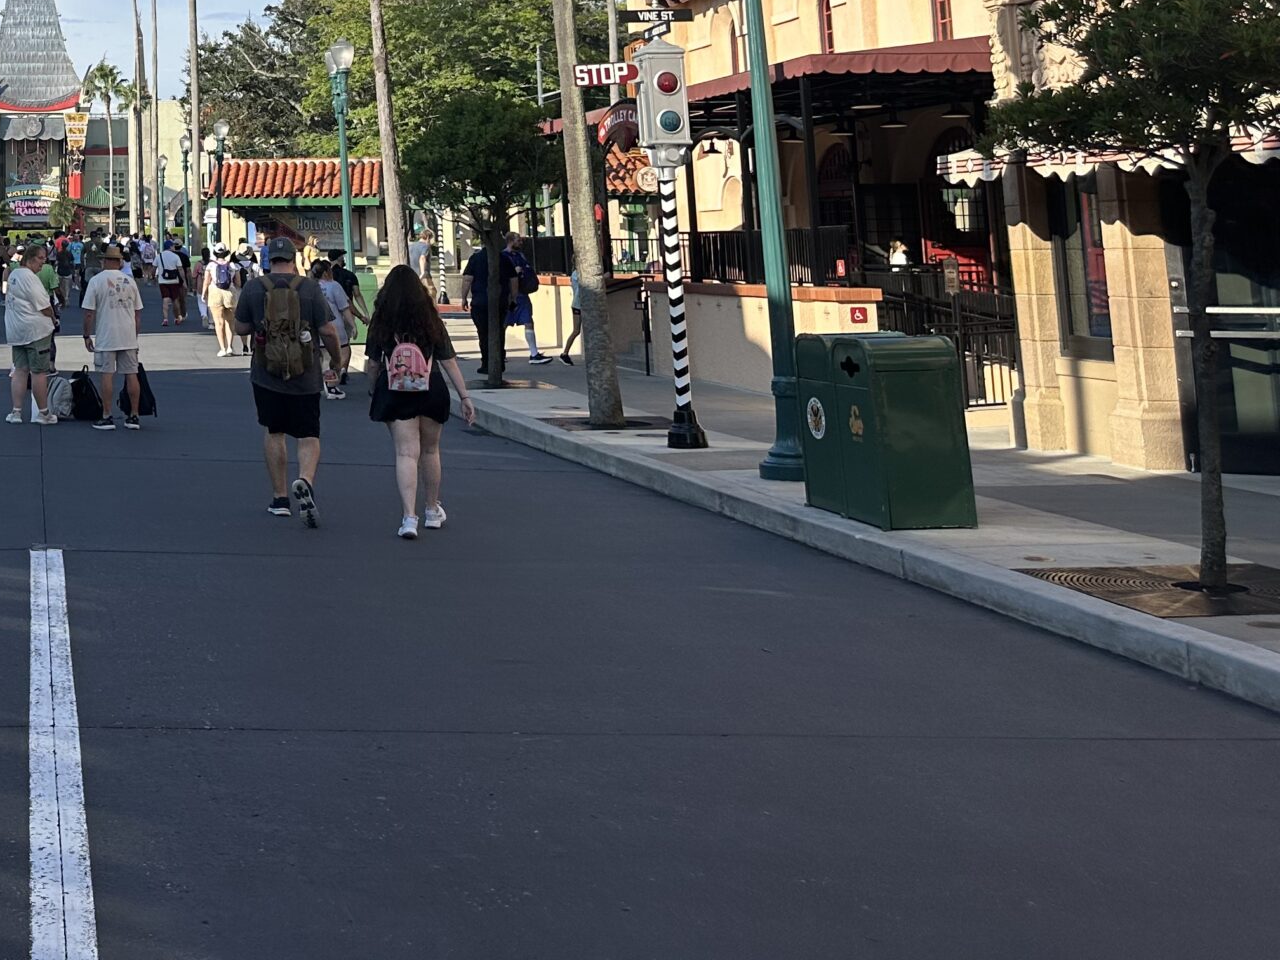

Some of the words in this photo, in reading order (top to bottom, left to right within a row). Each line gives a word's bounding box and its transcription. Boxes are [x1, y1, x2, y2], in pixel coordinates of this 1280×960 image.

[638, 11, 658, 21] VINE
[660, 11, 675, 21] ST.
[575, 62, 628, 86] STOP
[604, 109, 627, 131] TROLLEY
[628, 110, 639, 124] CA
[297, 217, 344, 231] HOLLYWOO
